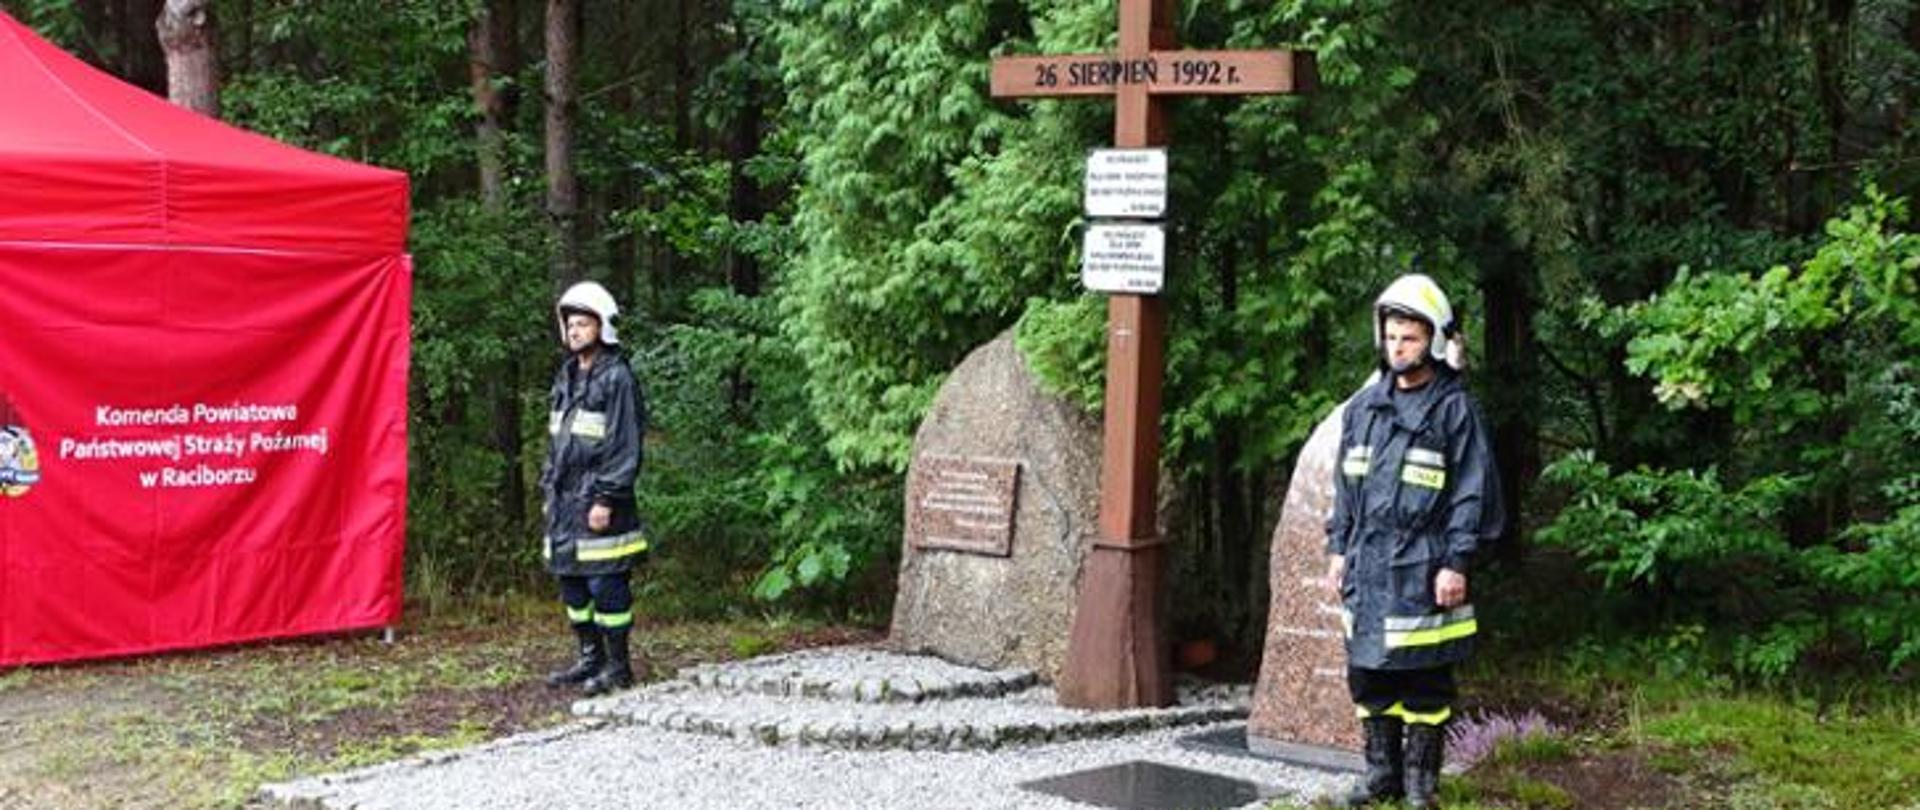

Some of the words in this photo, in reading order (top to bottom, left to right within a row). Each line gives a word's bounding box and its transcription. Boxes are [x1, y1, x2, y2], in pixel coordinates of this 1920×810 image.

[1035, 63, 1058, 87] 26
[1068, 58, 1158, 86] SIERPIEŃ
[1172, 61, 1221, 85] 1992
[1227, 66, 1240, 85] r.
[96, 404, 189, 425] Komenda
[193, 401, 297, 422] Powiatowa
[60, 435, 181, 461] Państwowej
[184, 434, 245, 458] Straży
[139, 471, 158, 487] w
[161, 464, 256, 488] Raciborzu
